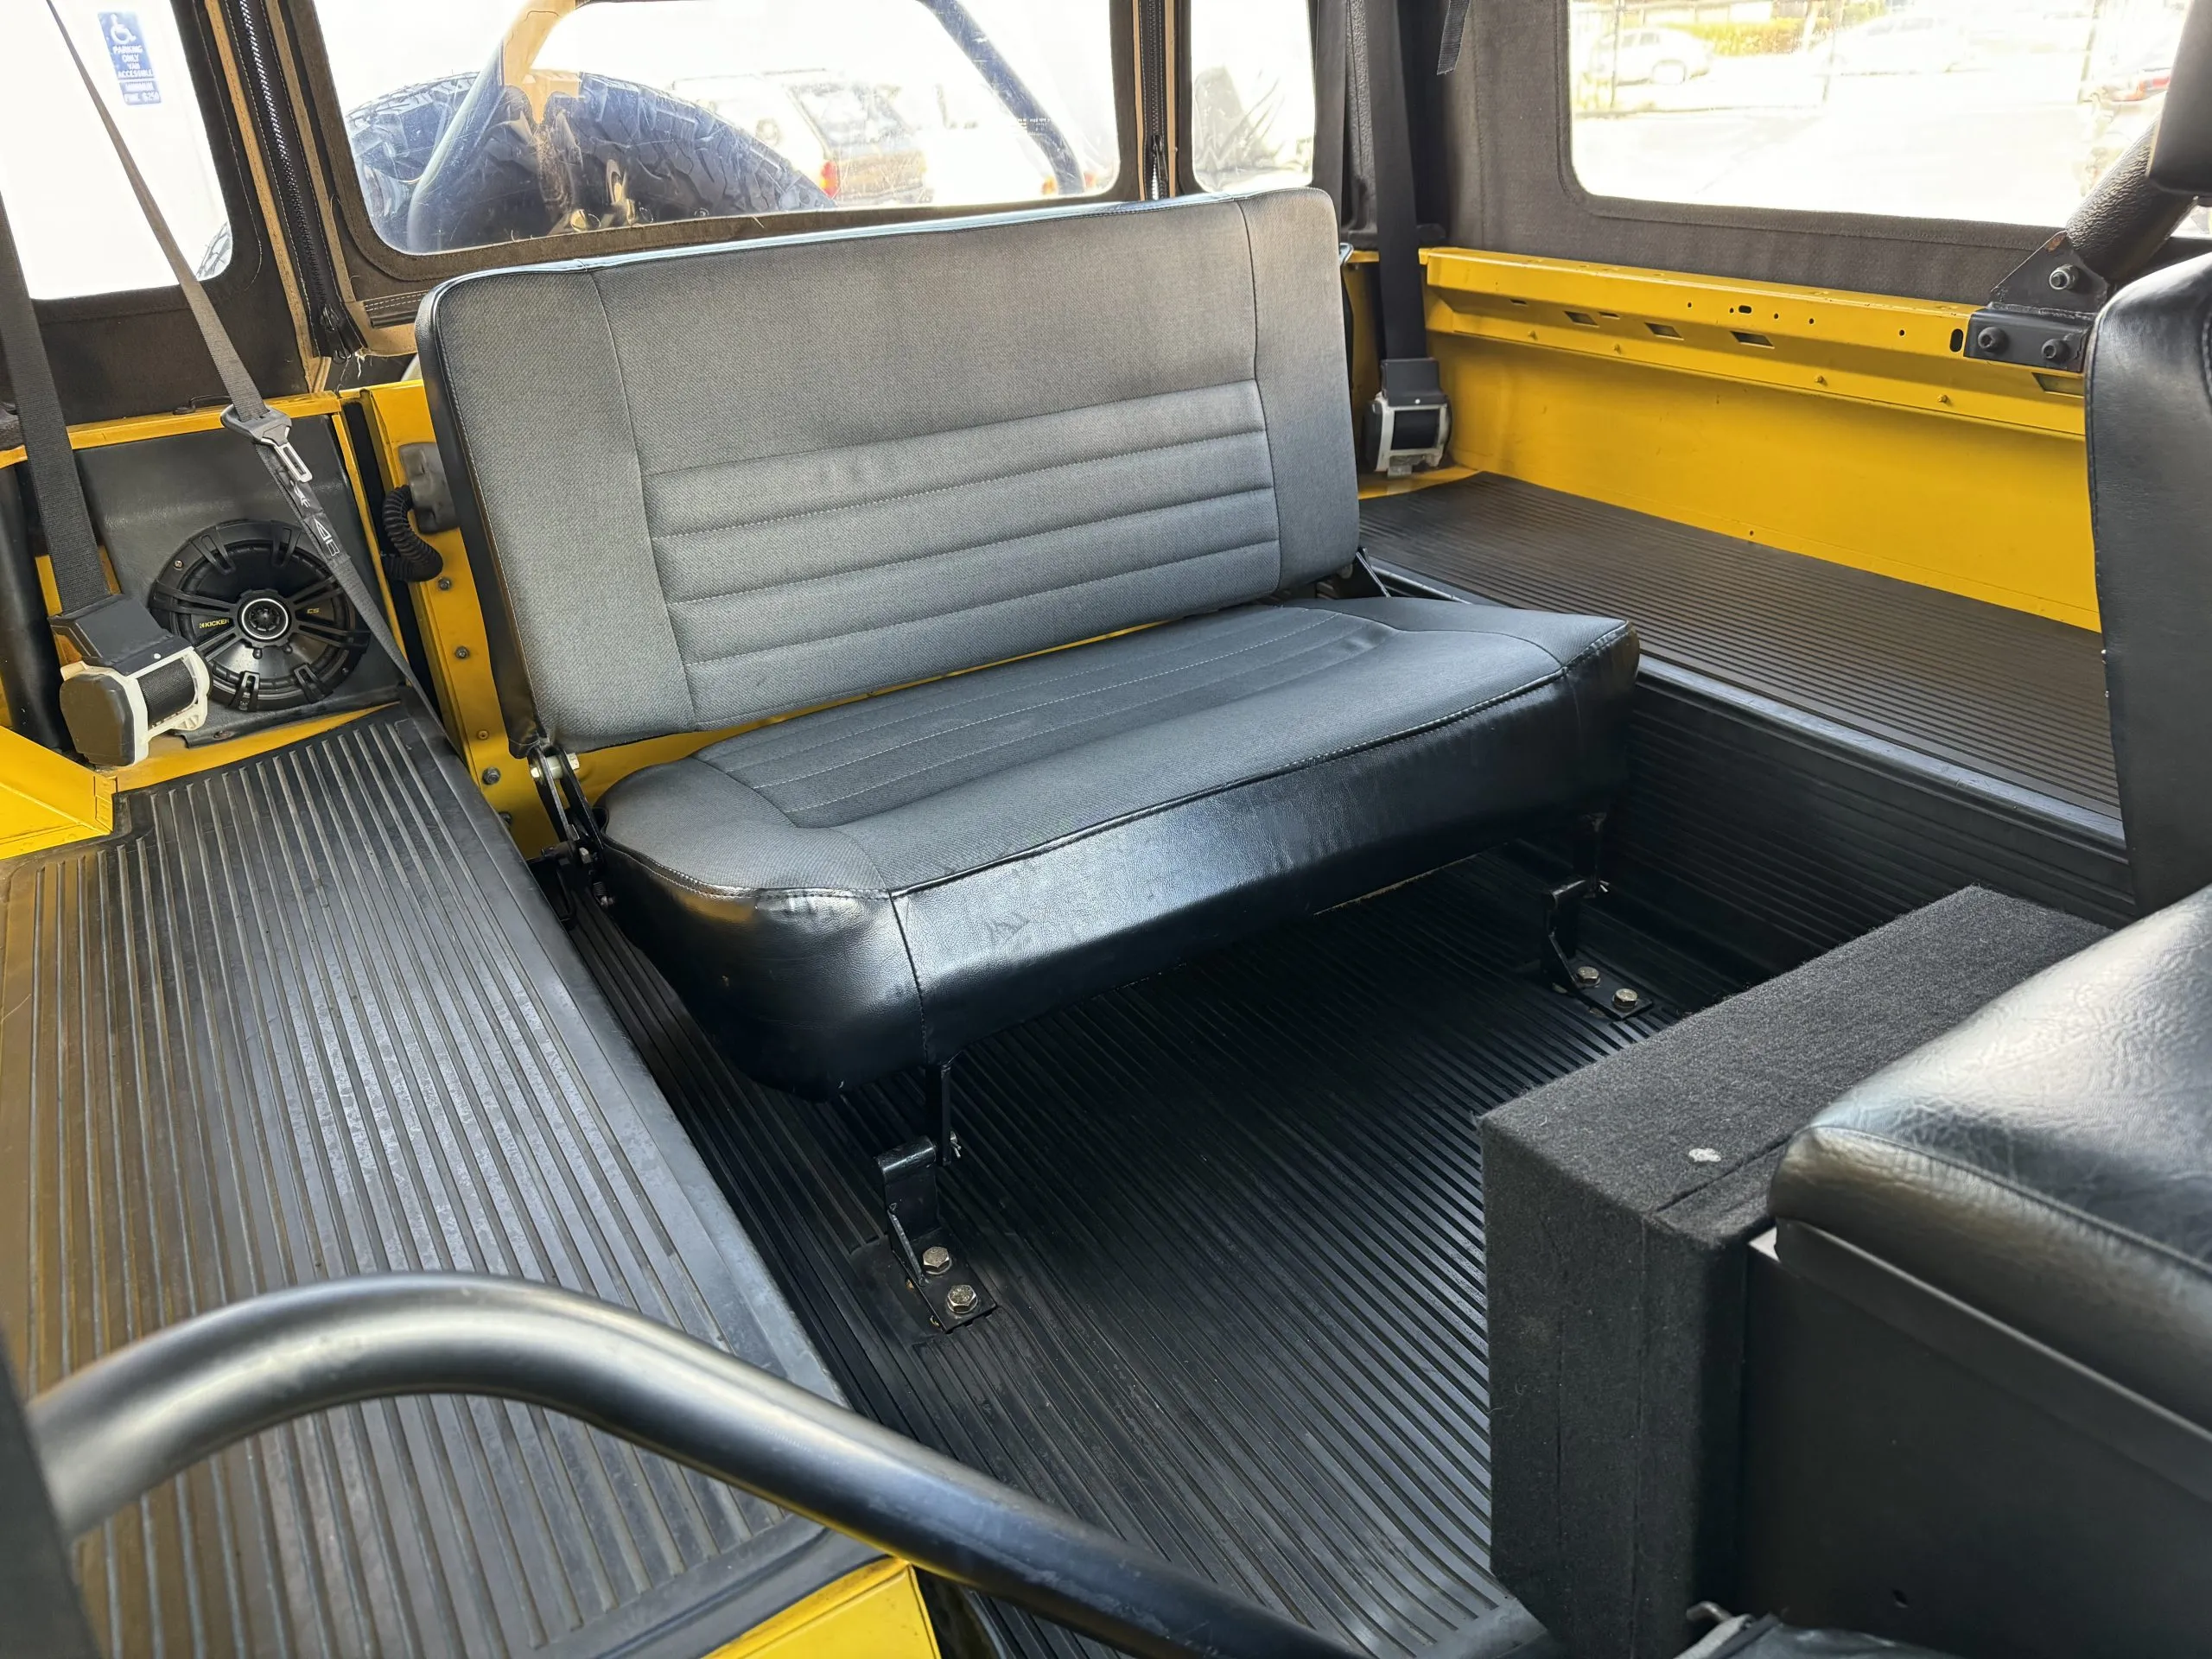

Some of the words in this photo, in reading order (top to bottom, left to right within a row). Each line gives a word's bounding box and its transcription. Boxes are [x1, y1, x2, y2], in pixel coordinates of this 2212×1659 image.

[112, 45, 143, 54] PARKING
[122, 54, 139, 62] ONLY
[205, 619, 230, 627] KICKER
